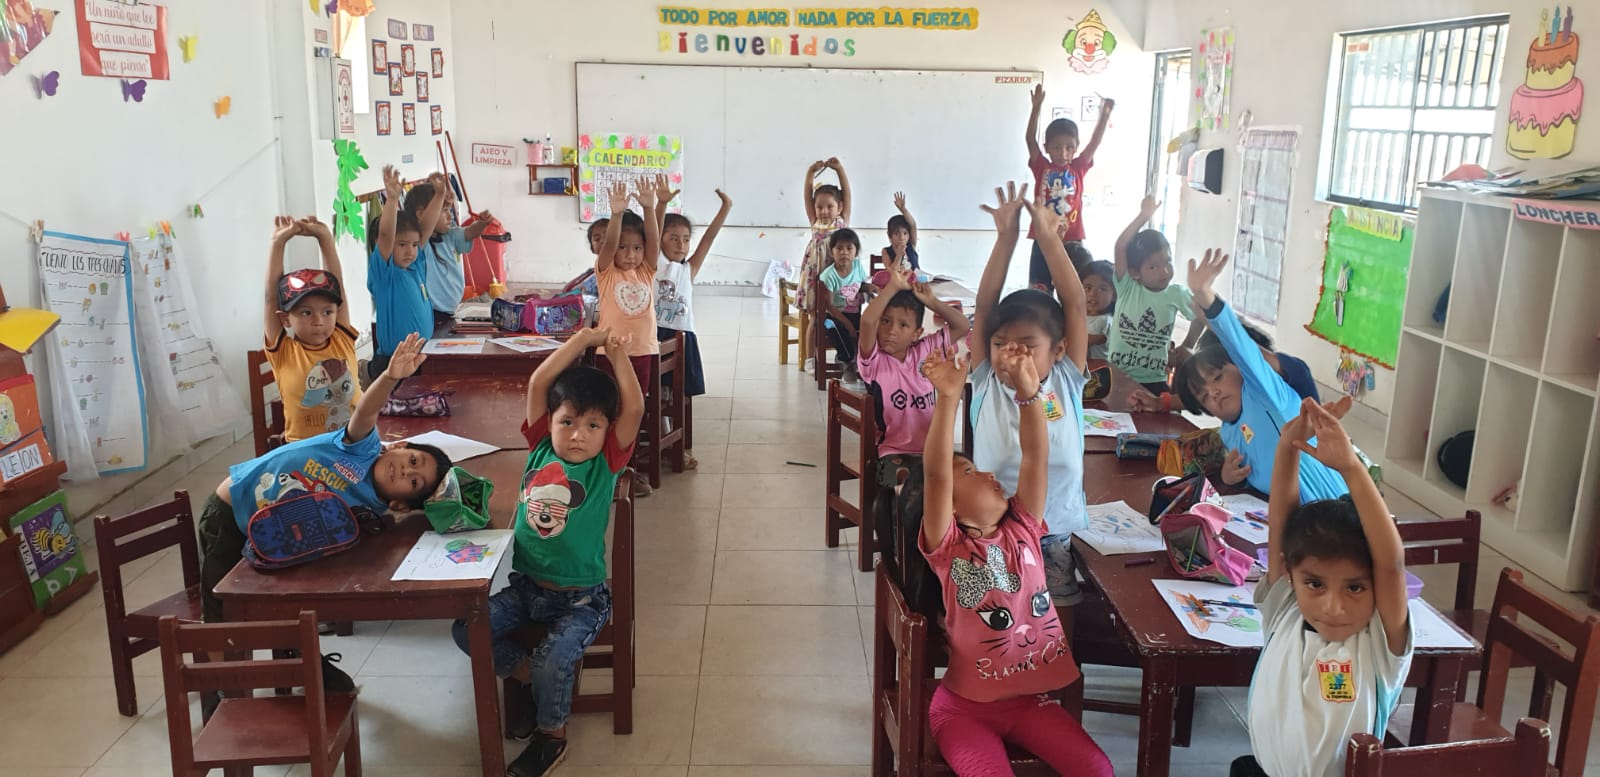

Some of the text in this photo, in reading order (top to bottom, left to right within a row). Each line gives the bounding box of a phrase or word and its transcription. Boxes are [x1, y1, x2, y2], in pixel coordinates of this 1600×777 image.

[660, 8, 971, 27] TODO POR AMOR NADA POR LA FUERZA
[475, 156, 512, 166] LIMPIEZA
[480, 147, 500, 156] ASEO
[594, 152, 667, 166] CALENDARIO
[1516, 203, 1600, 226] LONCHER
[308, 370, 328, 389] Cool
[304, 414, 326, 427] HELLO
[304, 458, 349, 492] RESCUE
[333, 462, 361, 485] RESCUE
[18, 531, 37, 578] BEJA
